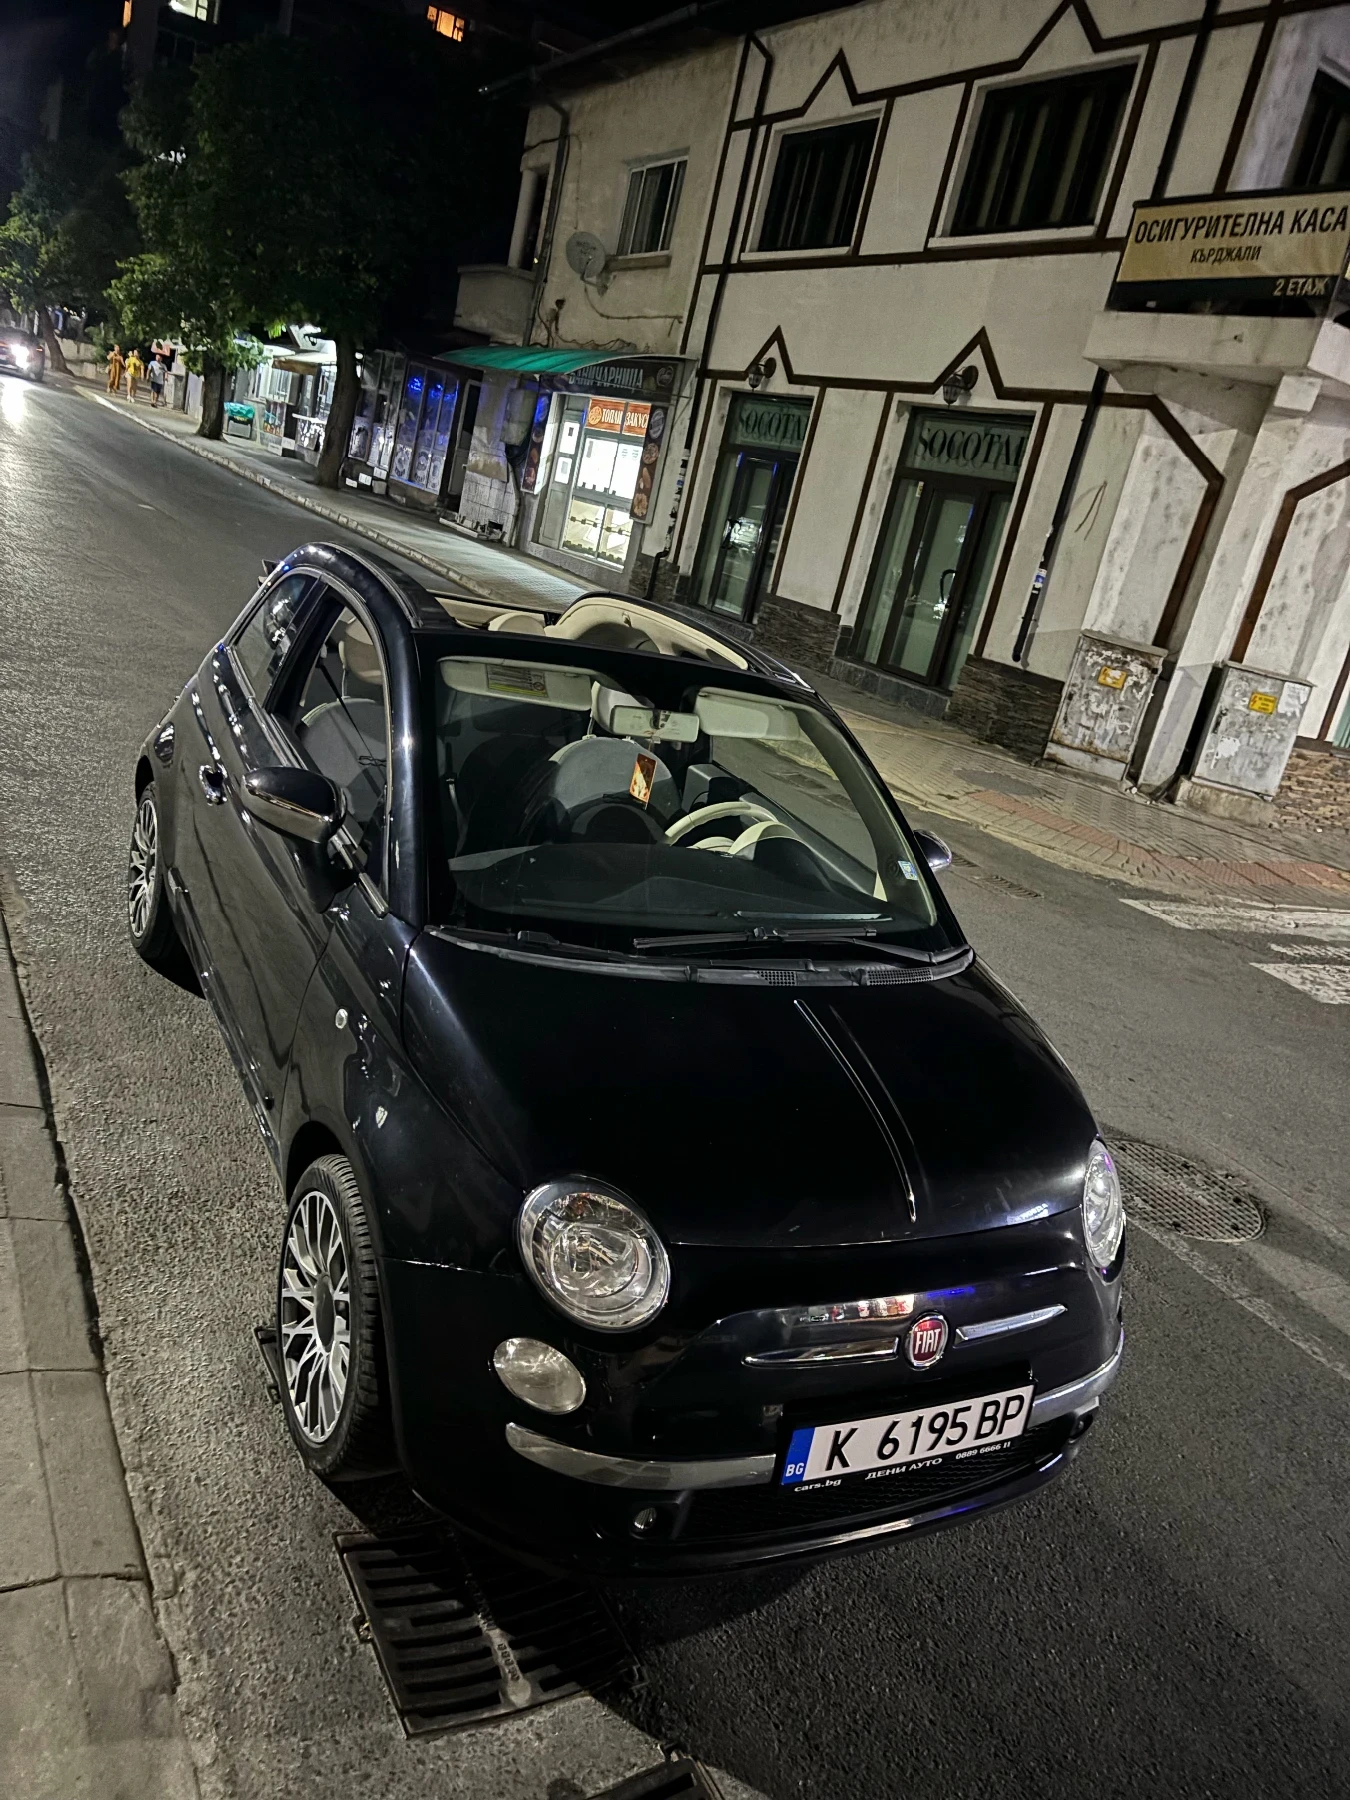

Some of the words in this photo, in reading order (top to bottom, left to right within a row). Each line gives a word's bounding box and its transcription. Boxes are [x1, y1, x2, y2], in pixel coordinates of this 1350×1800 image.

[1134, 210, 1285, 244] ОСИГУРИТЕЛНА
[1289, 205, 1348, 235] КАСА
[1190, 245, 1261, 266] КЪРДЖАЛИ
[1272, 279, 1282, 296] 2
[1286, 278, 1329, 296] ЕТАЖ
[914, 1327, 941, 1355] FIAT
[824, 1426, 858, 1472] K
[785, 1461, 805, 1477] BG
[794, 1478, 842, 1492] cars.bg
[865, 1465, 907, 1481] ДЕНИ
[955, 1448, 978, 1461] 0889
